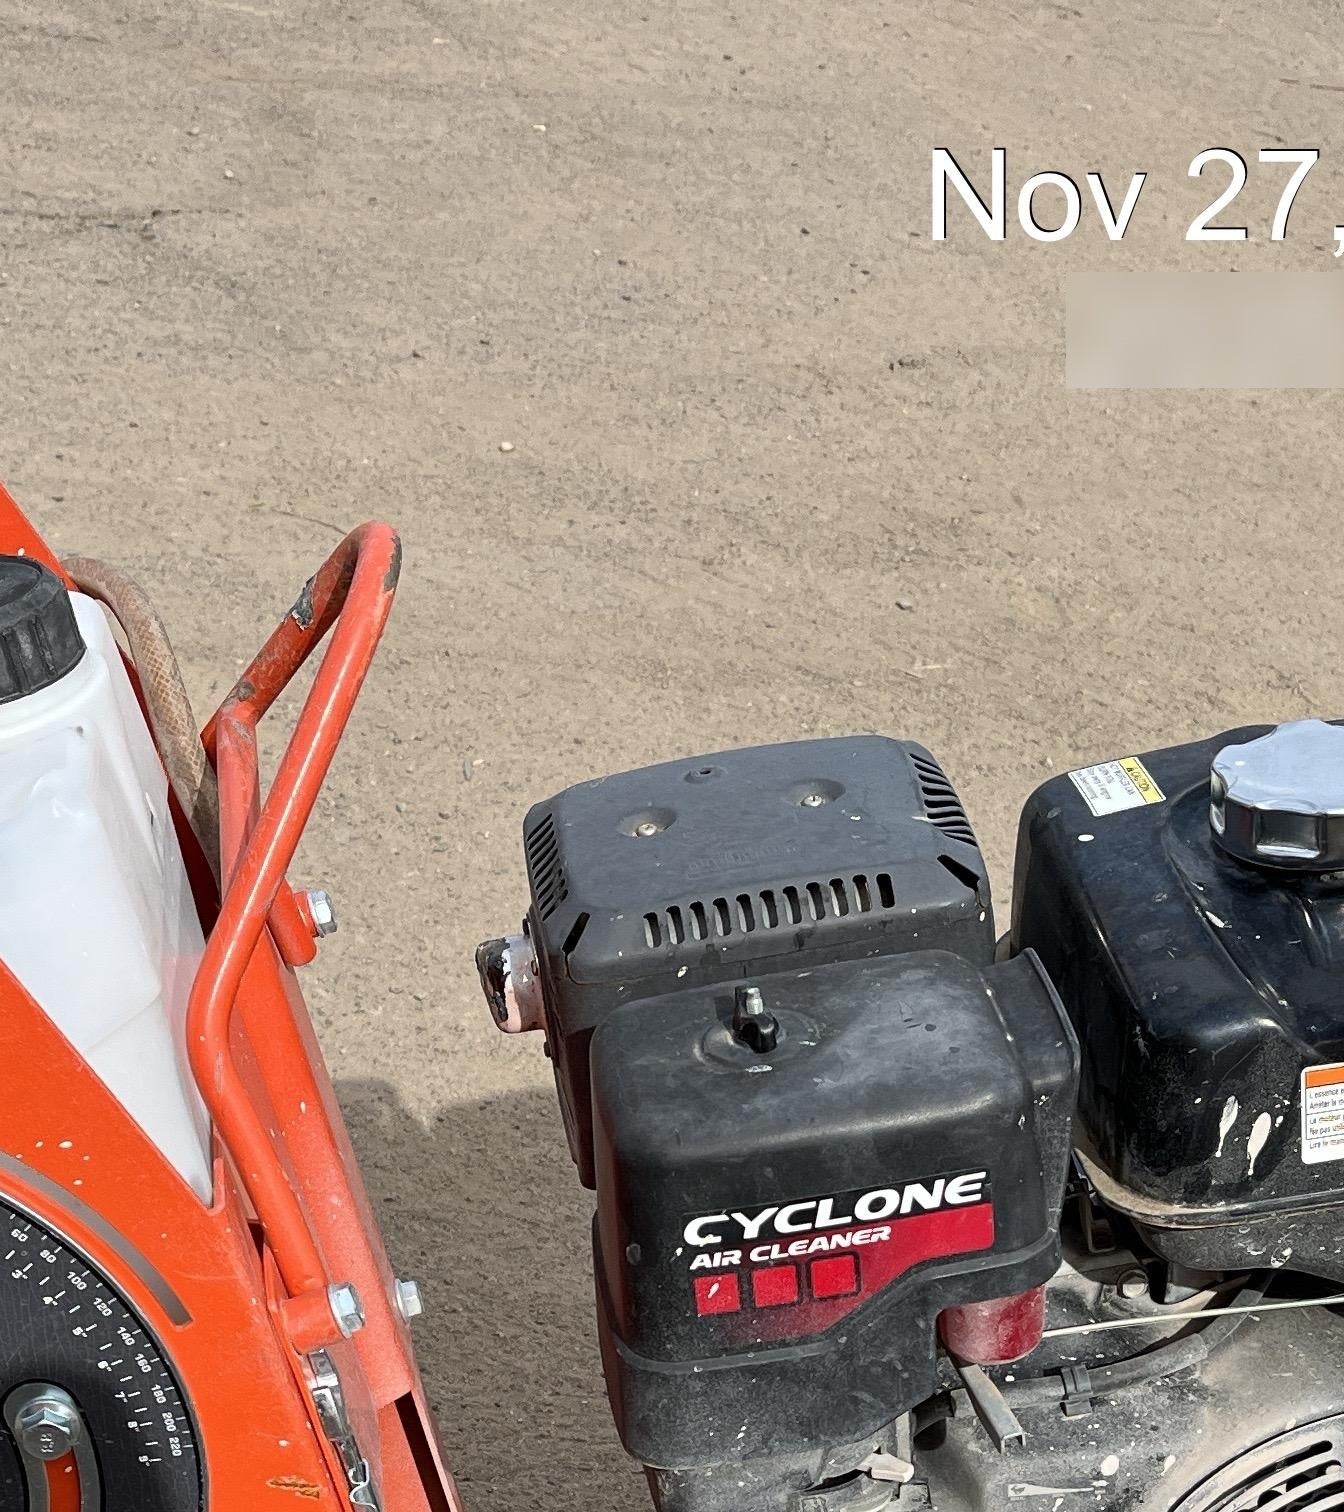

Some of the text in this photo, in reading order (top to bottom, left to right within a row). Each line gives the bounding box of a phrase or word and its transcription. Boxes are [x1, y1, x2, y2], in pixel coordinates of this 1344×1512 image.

[682, 1171, 988, 1248] CYCLONE
[10, 1229, 29, 1242] 60
[39, 1249, 57, 1264] 80
[689, 1226, 892, 1271] AIR CLEANER
[66, 1271, 87, 1291] 100
[93, 1297, 113, 1317] 120
[117, 1326, 135, 1346] 140
[134, 1353, 152, 1373] 160
[151, 1384, 167, 1404] 180
[162, 1411, 177, 1432] 200
[169, 1437, 182, 1457] 220
